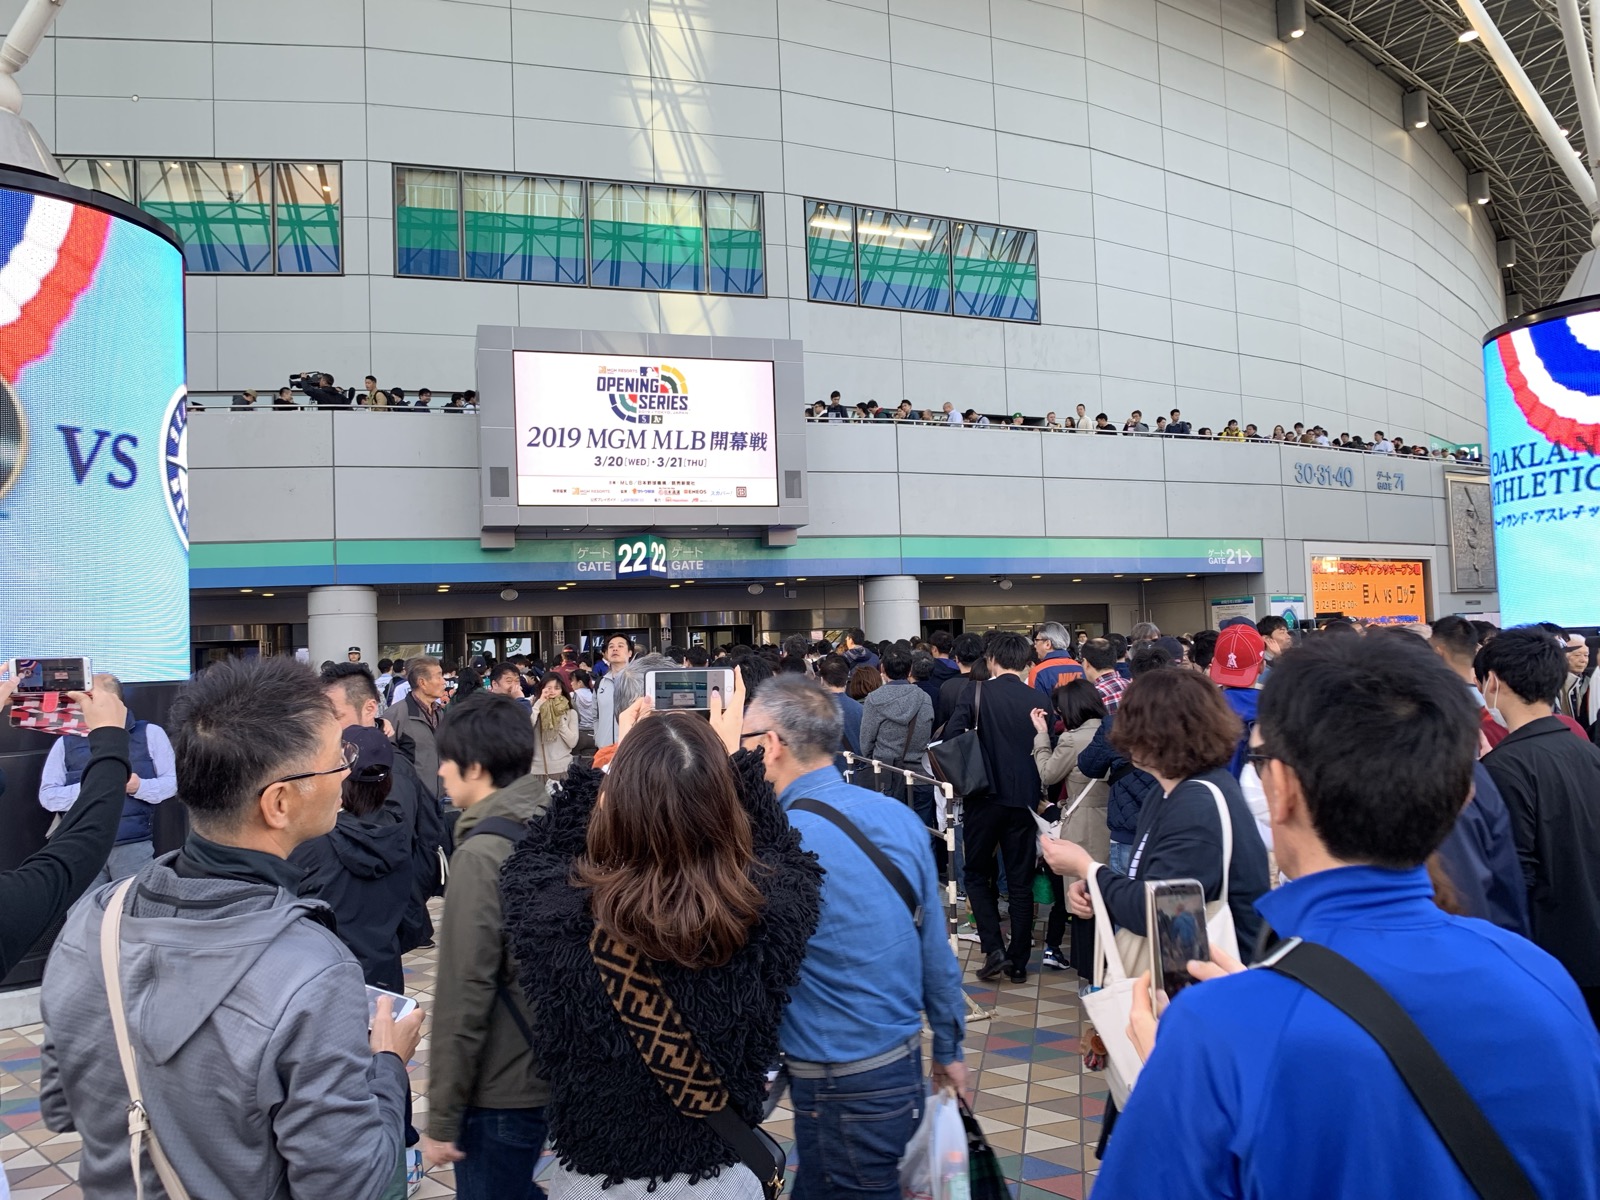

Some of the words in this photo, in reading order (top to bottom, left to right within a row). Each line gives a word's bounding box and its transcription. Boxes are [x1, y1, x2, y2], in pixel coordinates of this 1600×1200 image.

[597, 376, 660, 394] OPENING
[638, 394, 689, 411] SERIES
[526, 426, 582, 449] 2019
[586, 427, 648, 450] MGM
[651, 429, 706, 451] MLB
[709, 431, 768, 452] 開幕戦
[56, 424, 139, 490] VS
[1493, 464, 1600, 506] THLETIC
[577, 547, 611, 559] ゲート
[618, 541, 648, 574] 22
[650, 541, 667, 573] 22
[671, 546, 704, 558] ゲート
[1208, 549, 1226, 557] ゲート
[1226, 548, 1242, 565] 21
[577, 561, 612, 572] GATE
[671, 560, 704, 571] GATE
[1208, 557, 1226, 565] GATE
